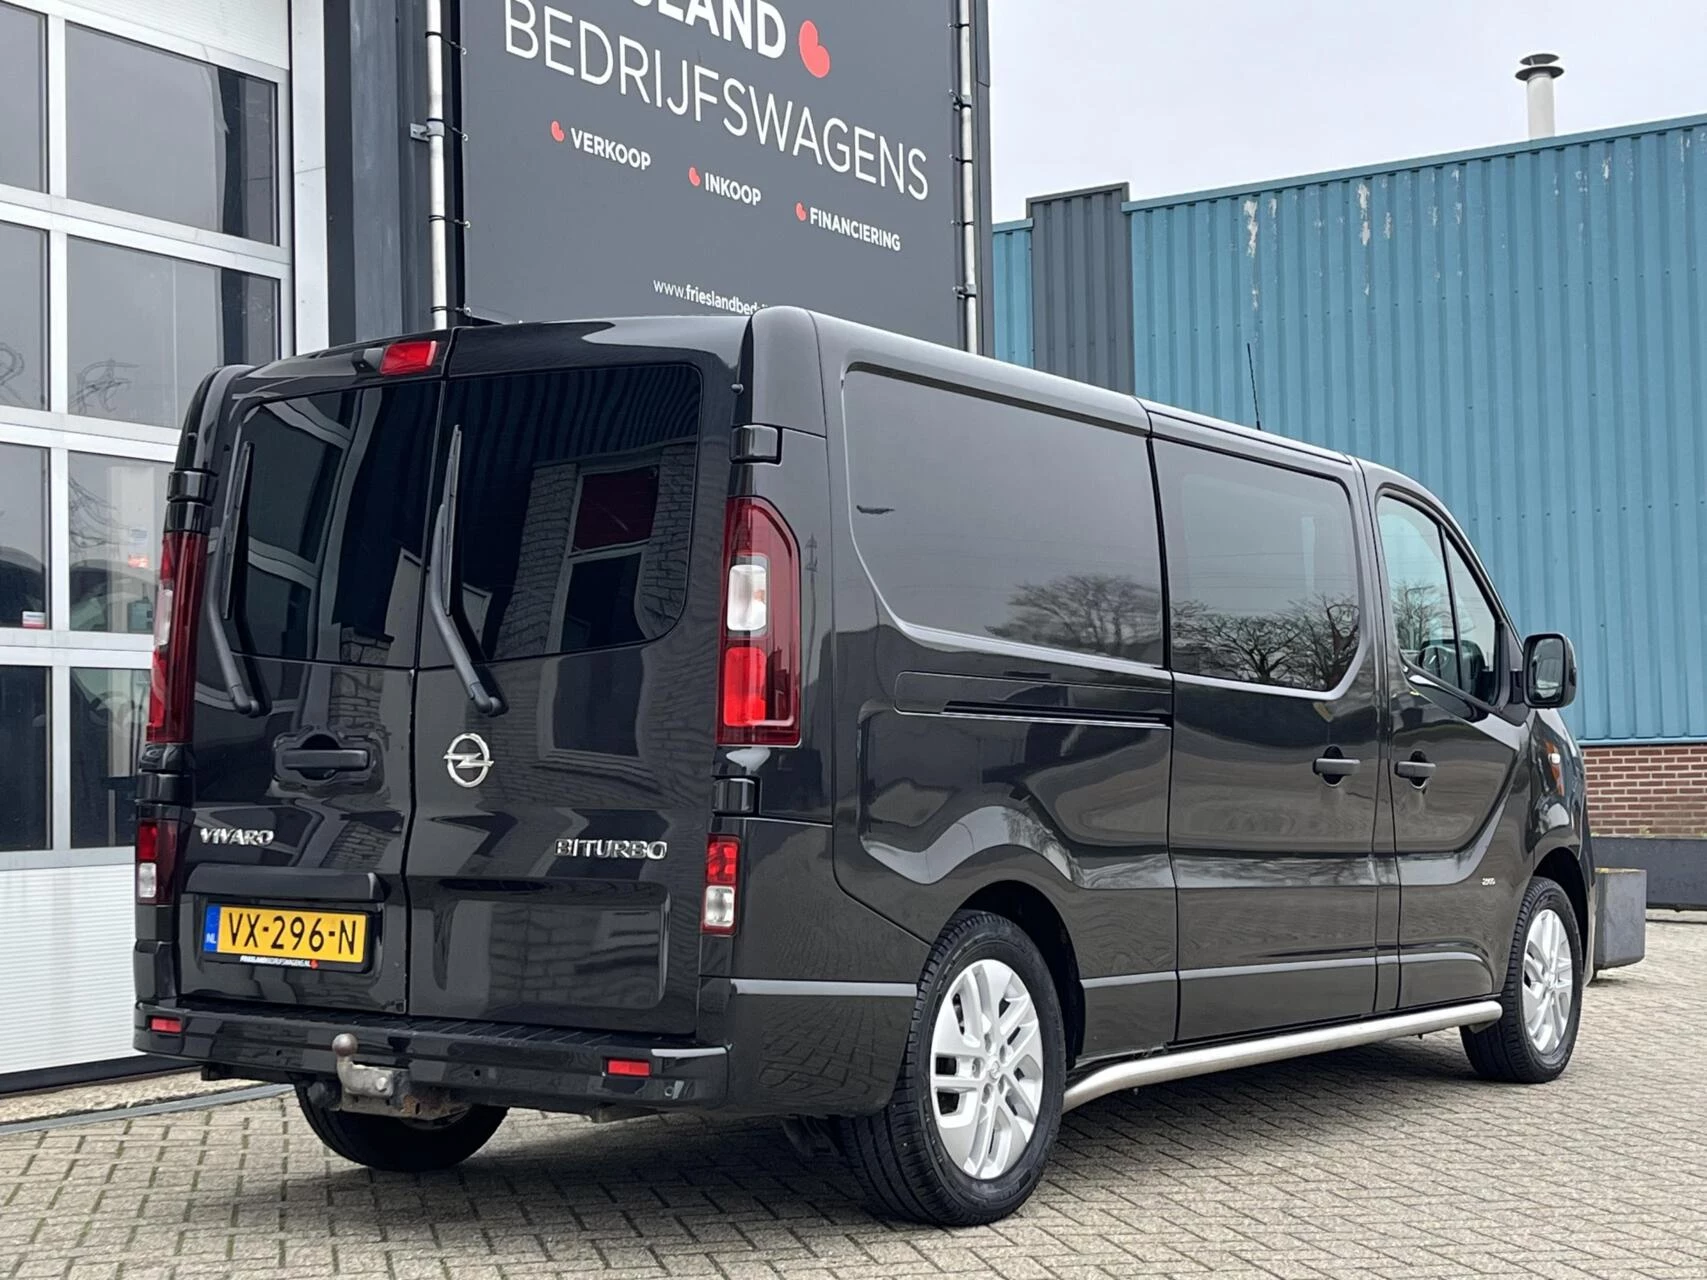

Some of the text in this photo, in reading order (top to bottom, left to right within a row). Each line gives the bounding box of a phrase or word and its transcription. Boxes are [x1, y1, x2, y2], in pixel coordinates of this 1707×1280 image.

[504, 0, 929, 201] BEDRIJFSWAGENS
[570, 127, 652, 171] VERKOOP
[704, 172, 762, 206] INKOOP
[809, 206, 901, 252] FINANCIERING
[652, 279, 768, 316] www.frieslandbed
[199, 827, 275, 846] VIVARO
[553, 837, 668, 861] BITURBO
[205, 932, 217, 945] NL
[228, 911, 357, 956] VX-296-N
